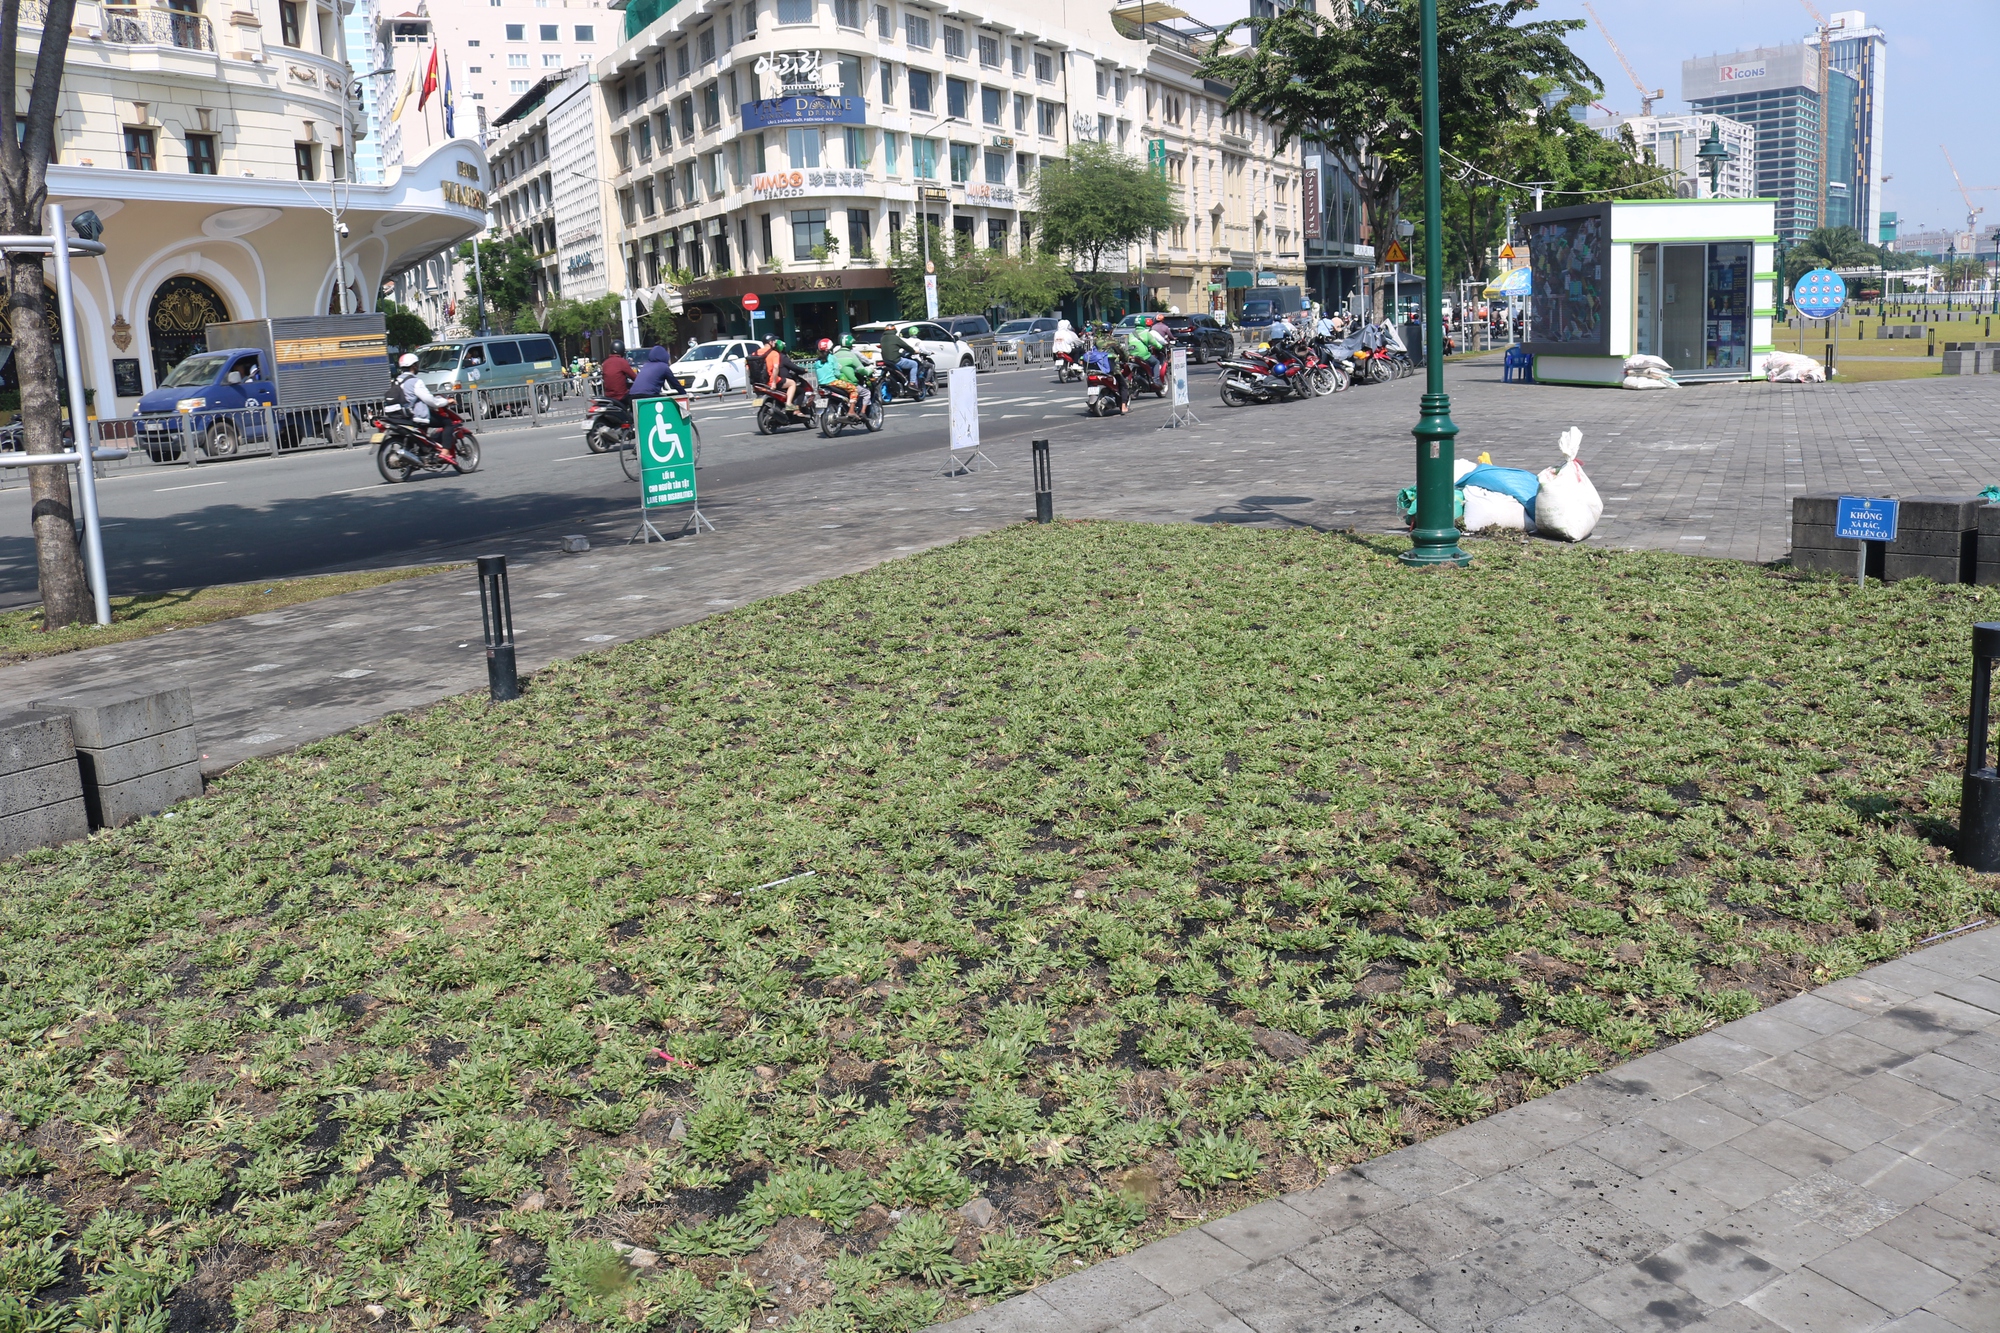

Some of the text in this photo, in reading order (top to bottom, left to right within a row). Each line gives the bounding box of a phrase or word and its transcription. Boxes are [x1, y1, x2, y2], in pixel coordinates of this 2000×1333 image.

[752, 100, 784, 116] THE
[808, 109, 843, 117] DRINKS
[754, 171, 804, 192] JUMBO
[764, 188, 804, 200] SEAFOOD
[1305, 171, 1316, 228] Riverside
[773, 274, 842, 291] RUNAM
[1850, 511, 1882, 520] KHÔNG
[1860, 528, 1875, 537] LÊN
